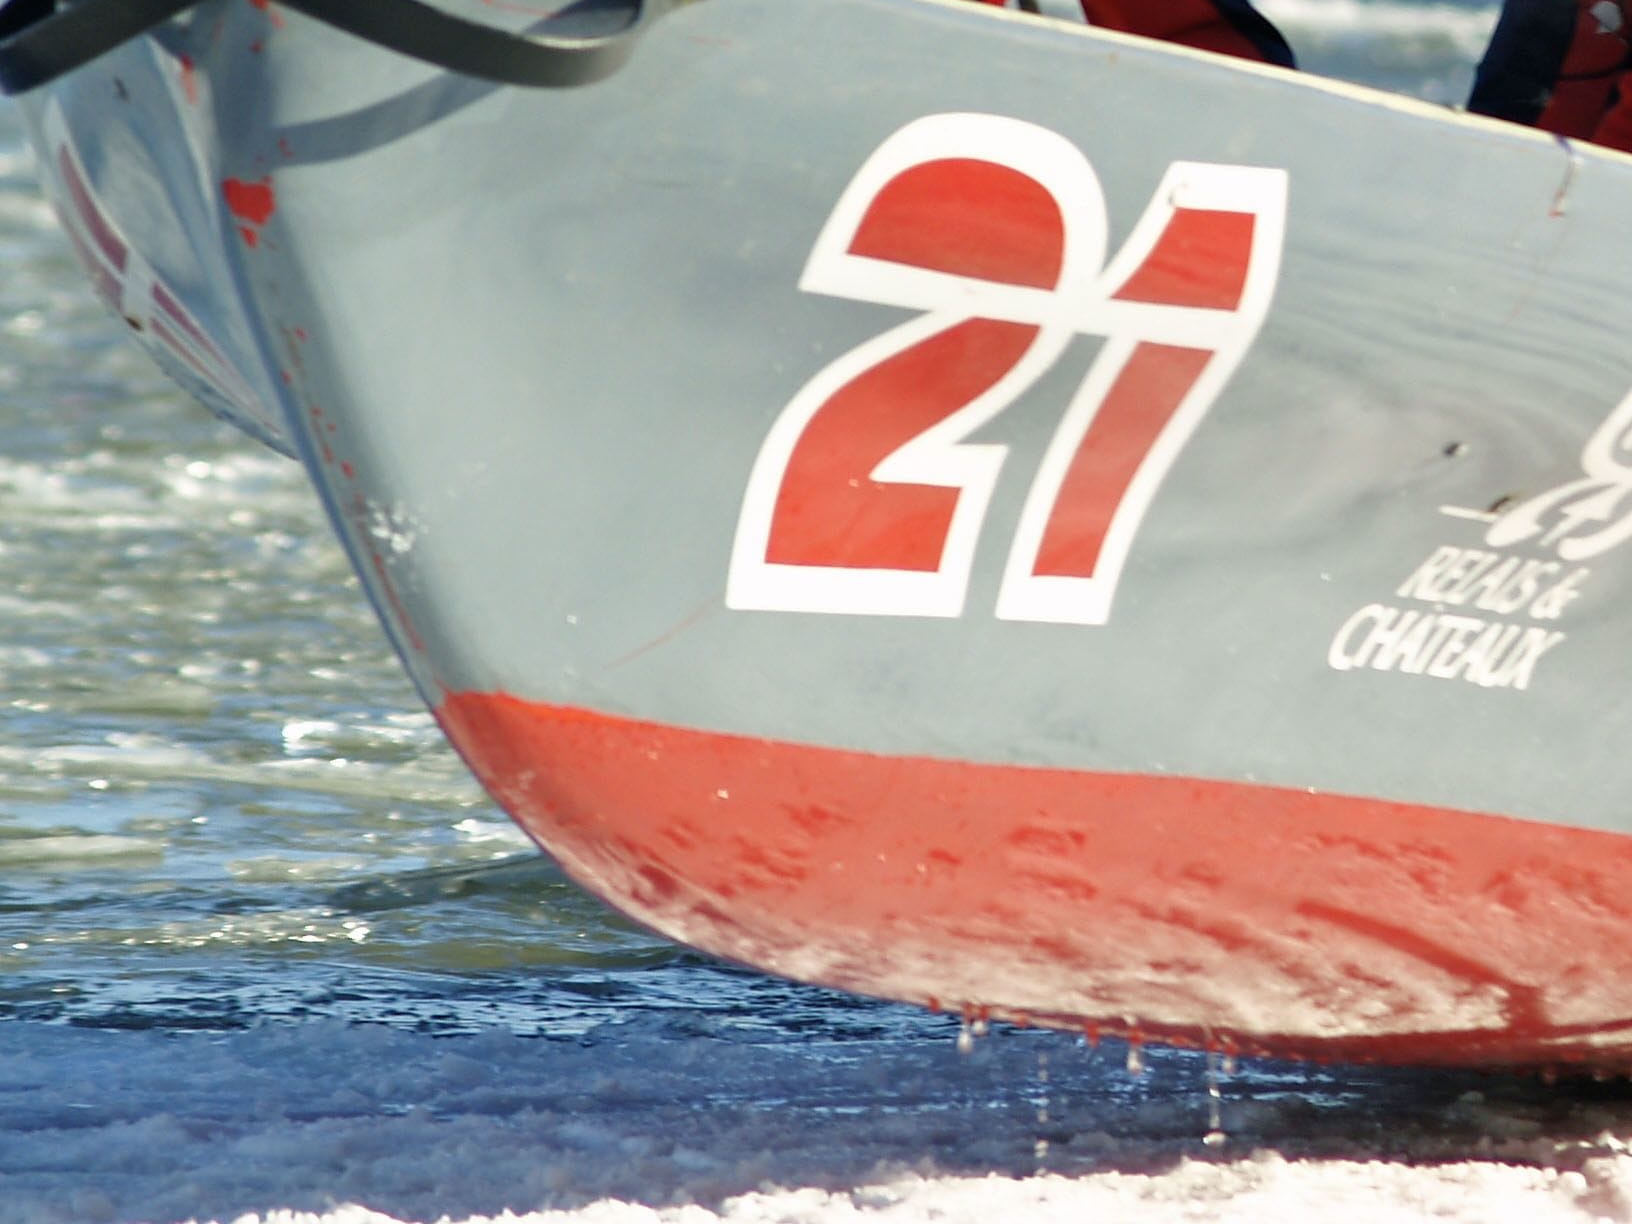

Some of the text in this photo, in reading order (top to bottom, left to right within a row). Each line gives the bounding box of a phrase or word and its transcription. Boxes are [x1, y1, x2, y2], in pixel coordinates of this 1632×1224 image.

[725, 112, 1288, 626] 21
[1396, 545, 1591, 619] RELAIS &
